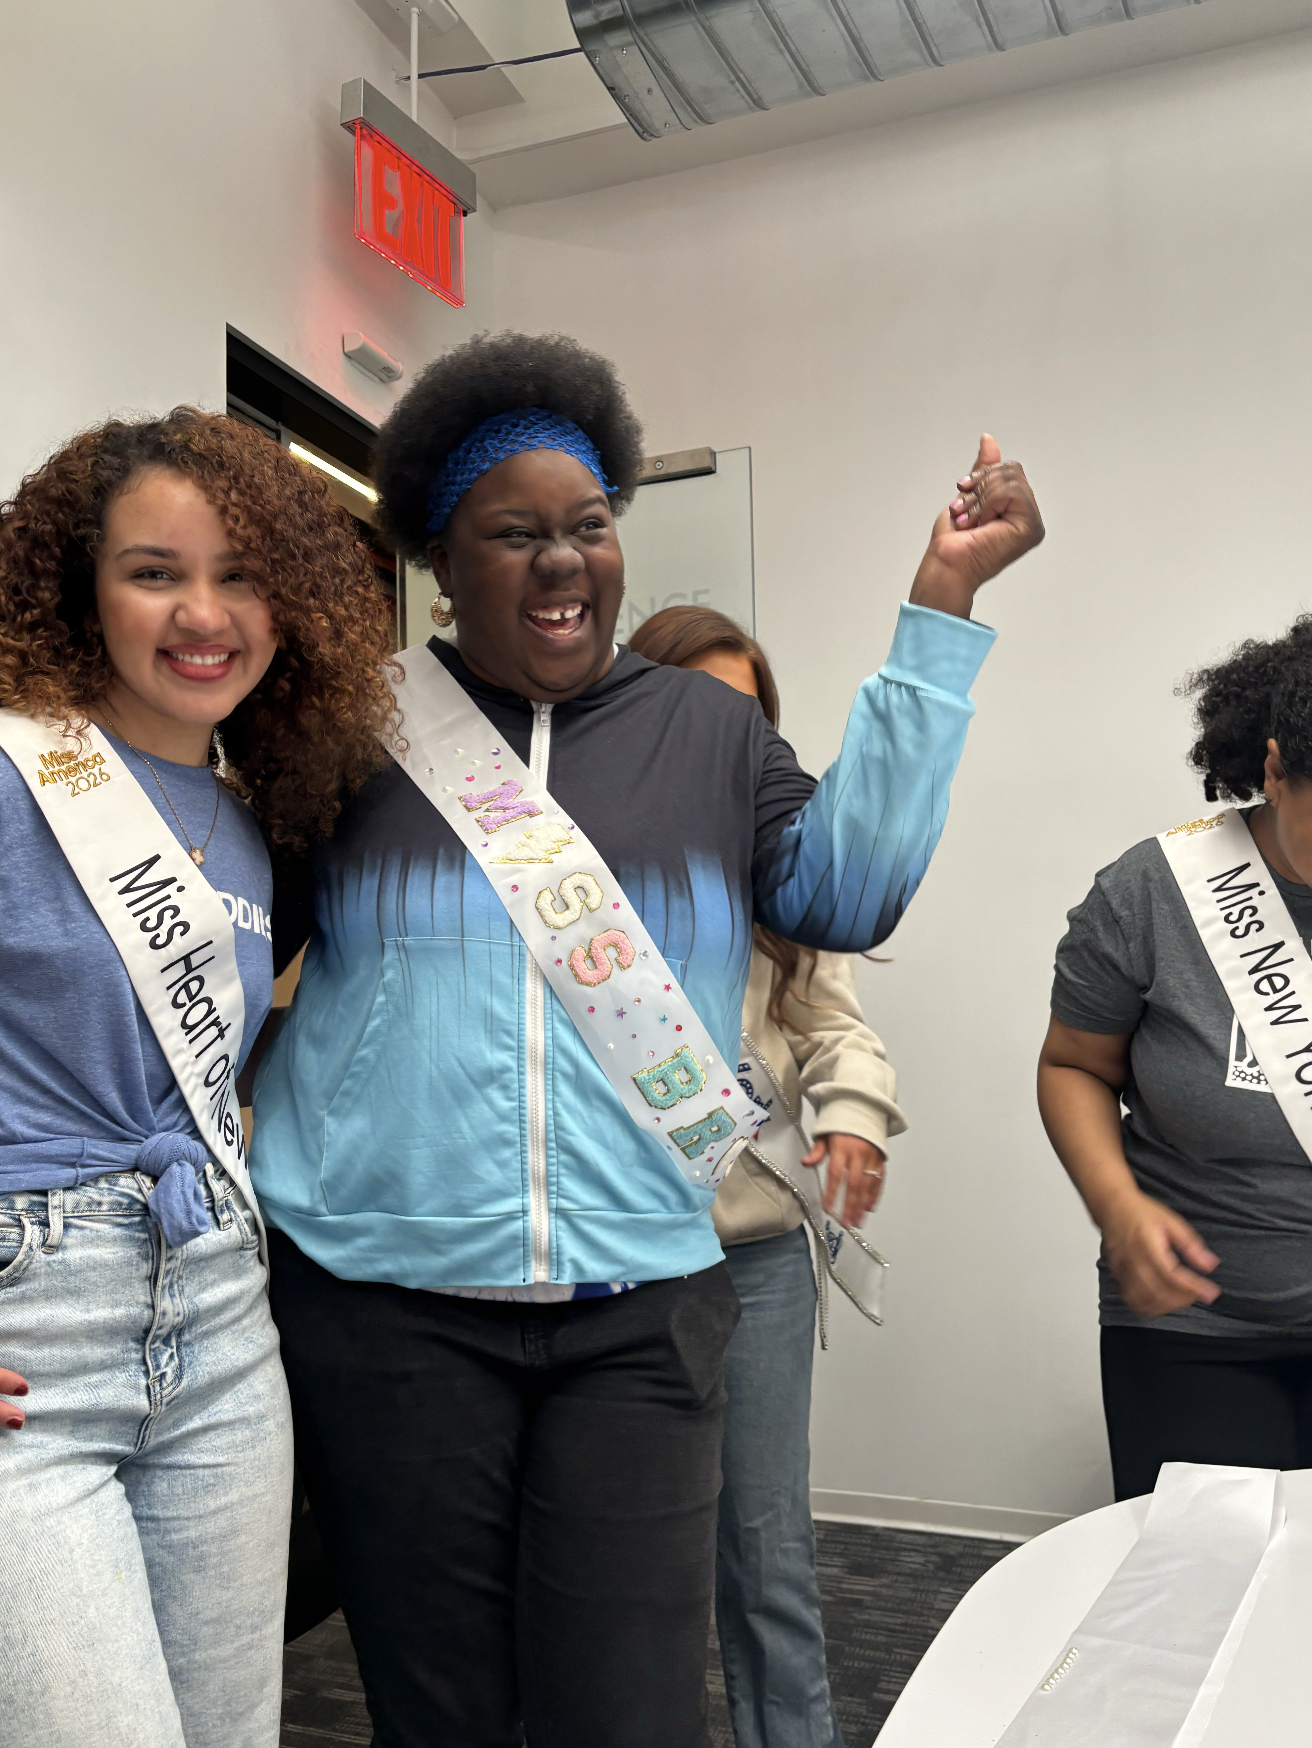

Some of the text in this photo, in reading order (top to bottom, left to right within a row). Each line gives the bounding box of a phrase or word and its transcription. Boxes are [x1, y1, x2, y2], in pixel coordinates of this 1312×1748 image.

[372, 140, 455, 290] EXIT
[37, 752, 106, 787] America
[38, 750, 78, 770] Miss
[65, 767, 110, 797] 2026
[109, 853, 190, 951] Miss
[160, 939, 231, 1059] Heart
[1206, 861, 1265, 939] Miss
[1239, 940, 1309, 1026] New
